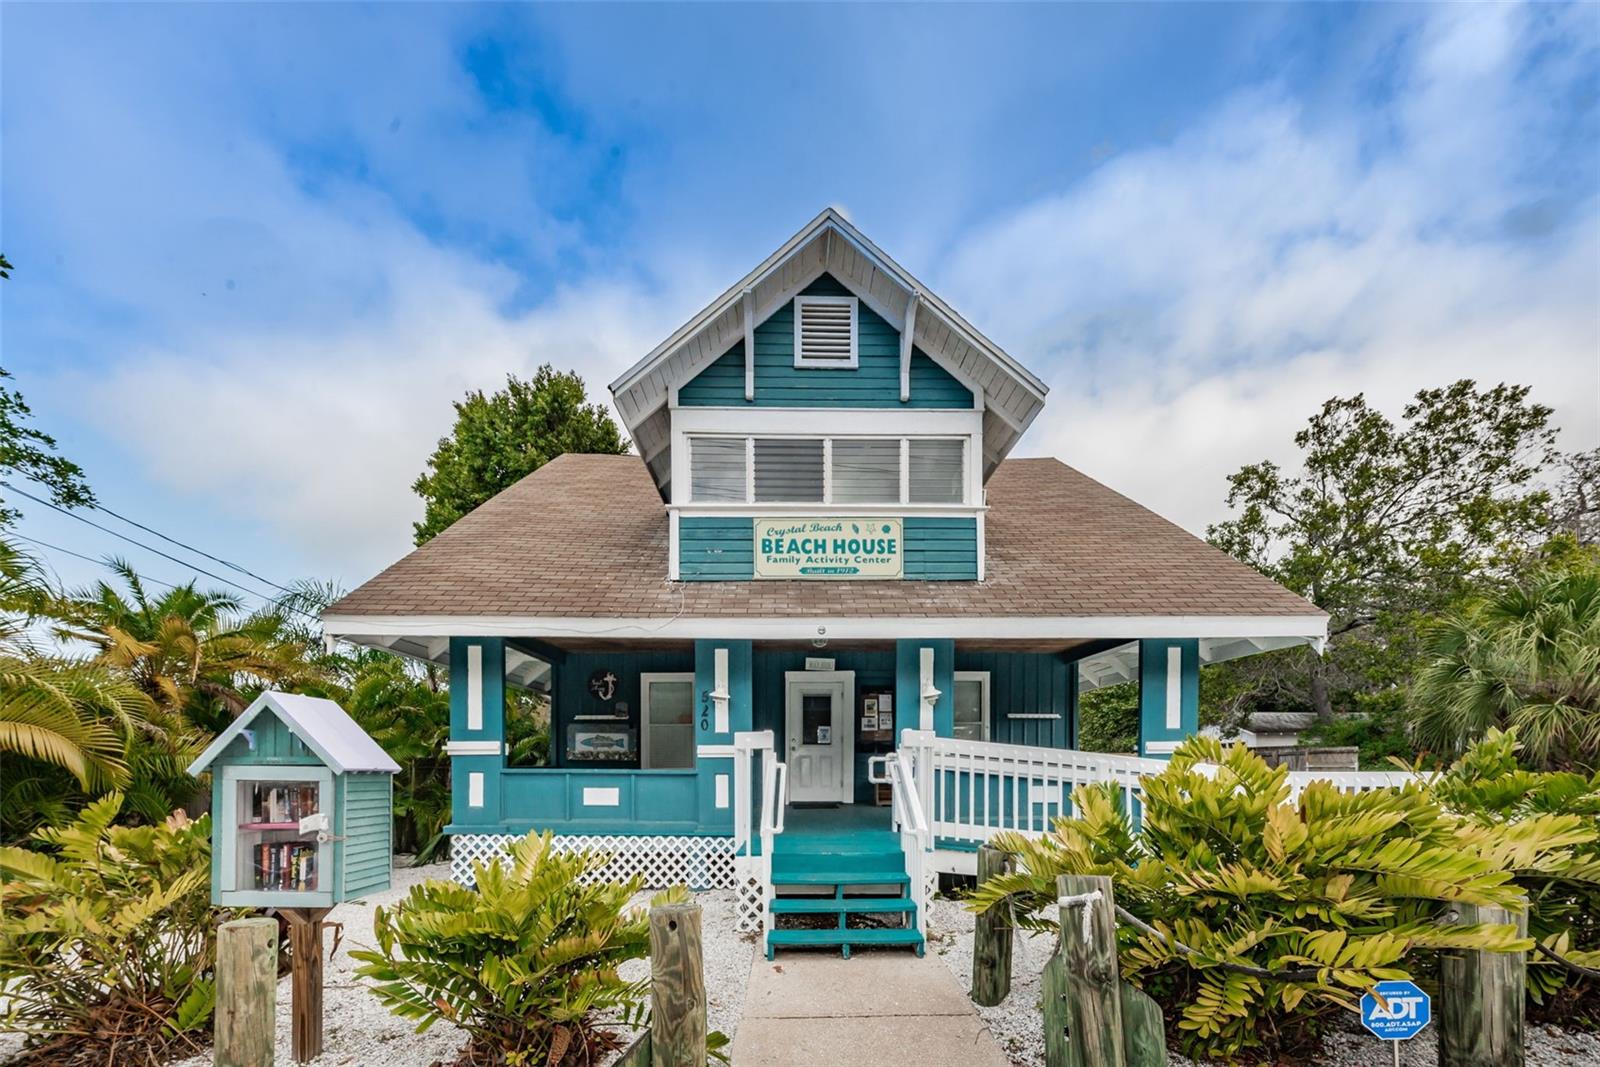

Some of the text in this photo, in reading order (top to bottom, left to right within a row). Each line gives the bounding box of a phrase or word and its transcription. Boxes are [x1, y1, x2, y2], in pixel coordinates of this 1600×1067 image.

[766, 522, 842, 537] Crystal Beach
[761, 538, 897, 554] BEACH HOUSE
[766, 555, 891, 565] Family Activity Center
[701, 689, 709, 731] 520
[1368, 996, 1424, 1020] ADT
